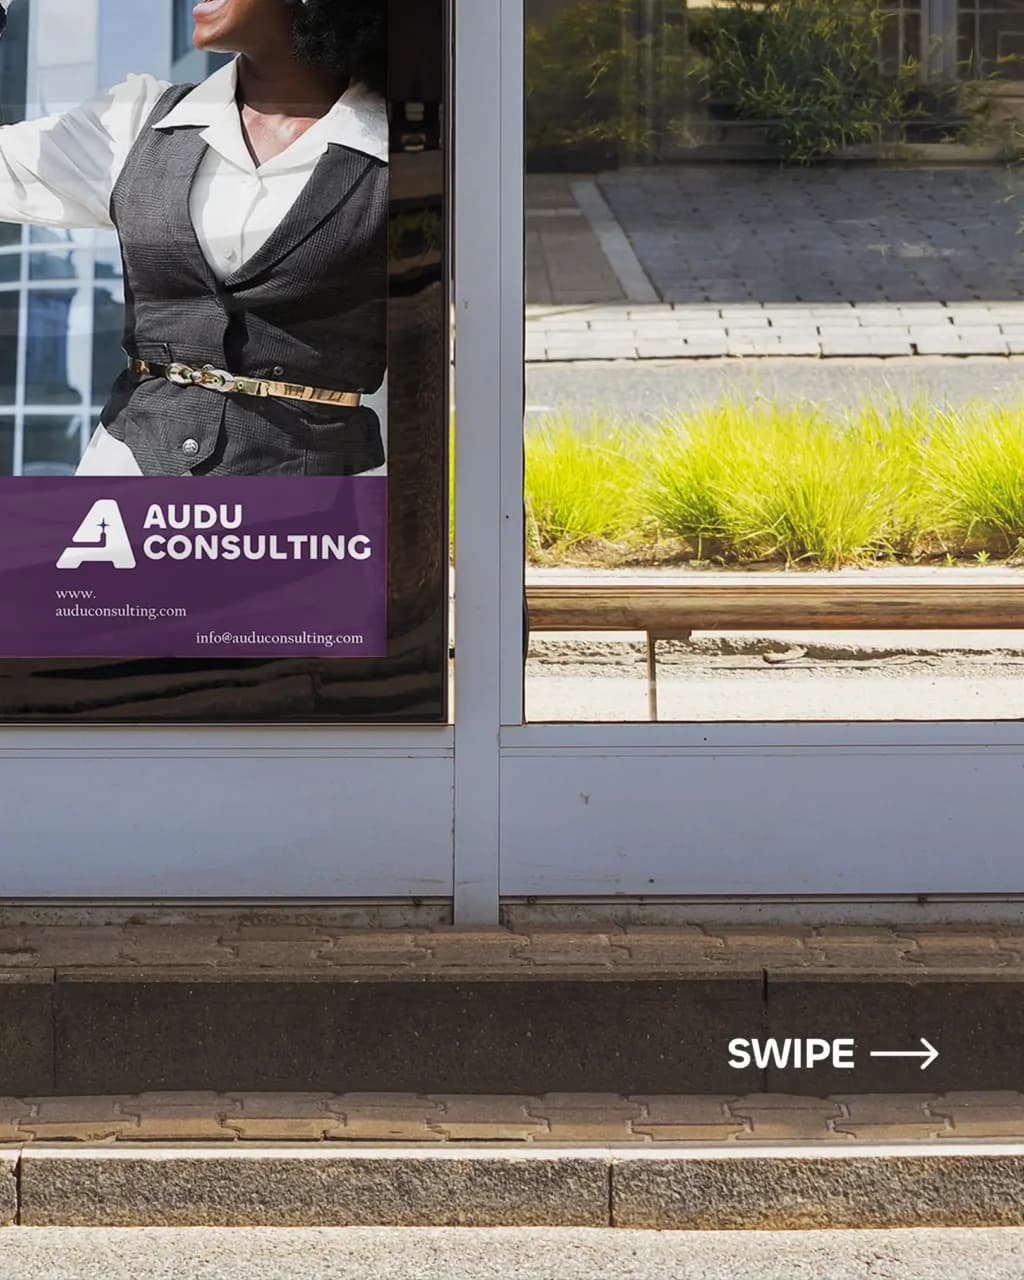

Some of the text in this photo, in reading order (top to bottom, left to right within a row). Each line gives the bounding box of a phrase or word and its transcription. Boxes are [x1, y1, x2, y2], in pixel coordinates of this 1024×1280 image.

[143, 503, 243, 529] AUDU
[143, 534, 371, 561] CONSULTING
[55, 590, 96, 599] www.
[55, 604, 187, 621] auduconsulting.com
[196, 631, 363, 648] info@auduconsulting.com
